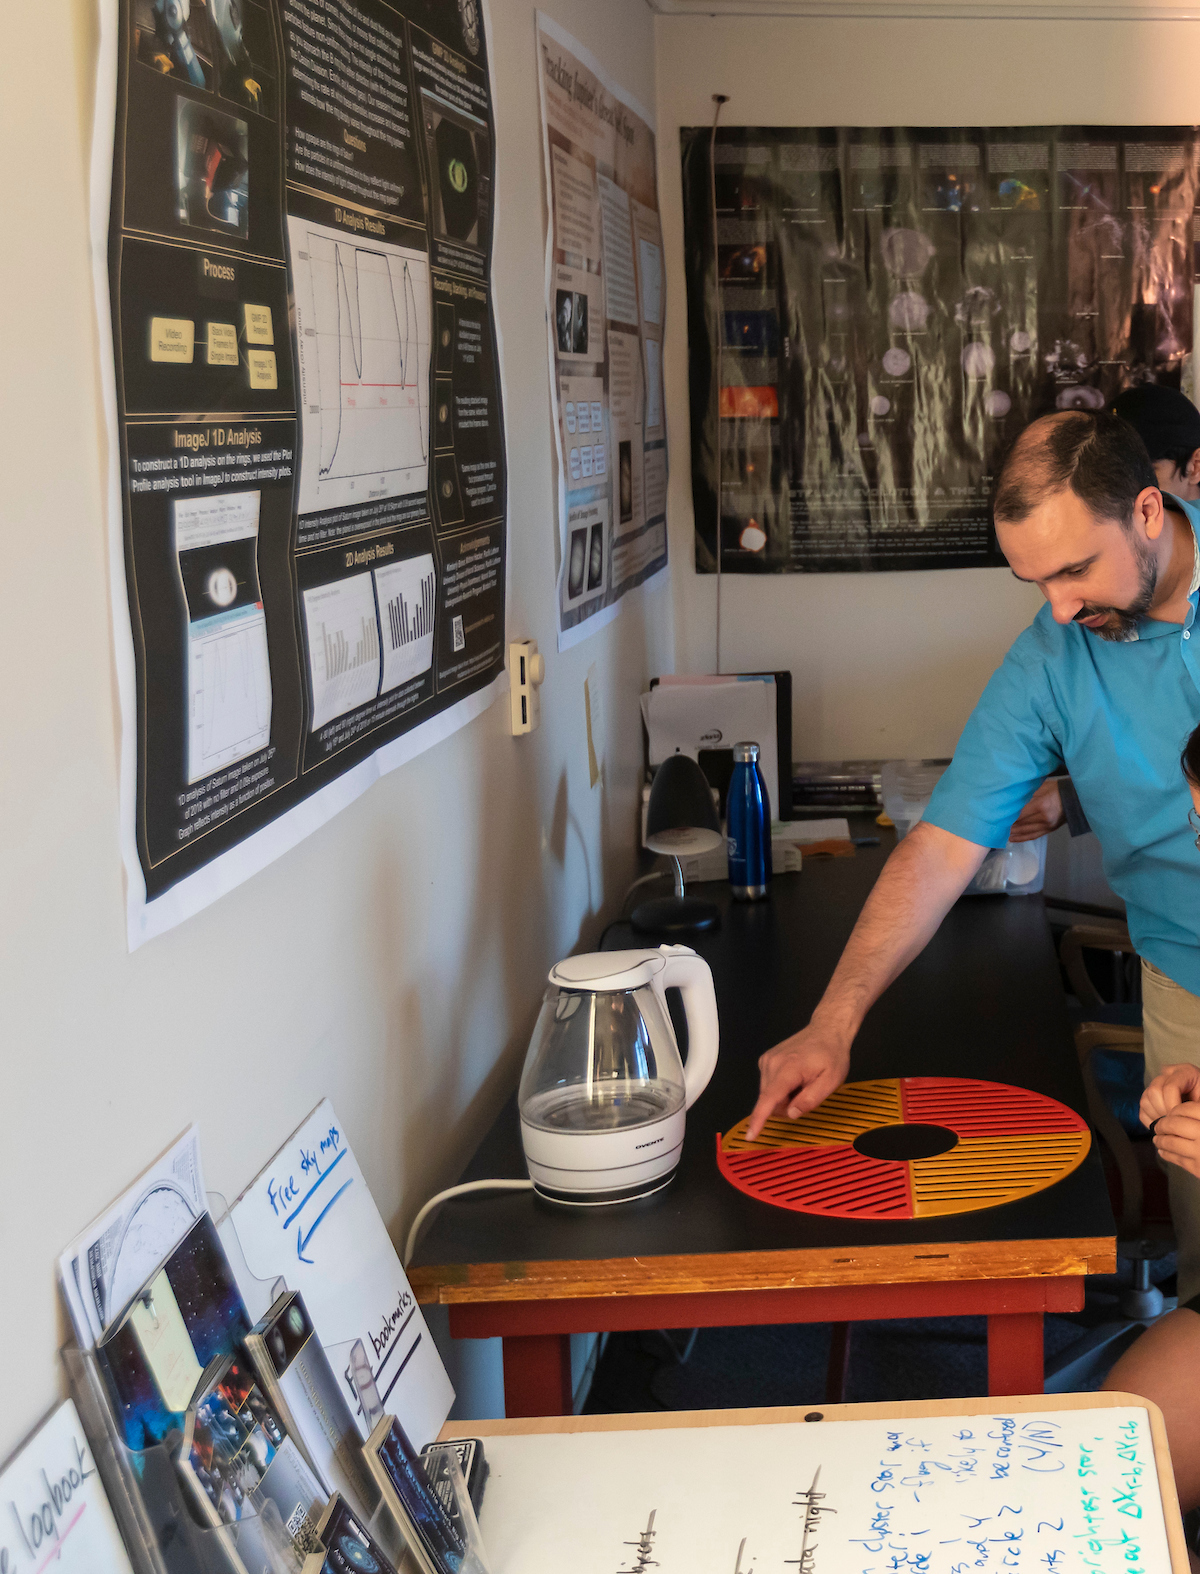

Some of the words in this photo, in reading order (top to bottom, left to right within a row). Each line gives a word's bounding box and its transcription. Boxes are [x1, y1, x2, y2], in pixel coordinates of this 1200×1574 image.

[344, 128, 366, 152] Questions
[343, 210, 365, 231] Analysis
[365, 217, 385, 235] Results
[204, 258, 235, 280] Process
[165, 328, 182, 339] Video
[212, 326, 223, 336] Stack
[223, 327, 234, 337] Video
[158, 340, 187, 354] Recording
[174, 429, 210, 451] ImageJ
[212, 428, 225, 446] 1D
[227, 428, 262, 448] Analysis
[133, 459, 142, 472] To
[142, 458, 172, 472] construct
[173, 460, 178, 469] a
[179, 456, 189, 468] 1D
[190, 455, 216, 469] analysis
[217, 457, 226, 466] on
[226, 454, 236, 465] the
[252, 454, 260, 463] we
[261, 451, 272, 461] used
[273, 450, 282, 460] the
[282, 449, 292, 460] Plot
[132, 479, 151, 492] Profile
[153, 476, 179, 492] analysis
[181, 474, 194, 487] tool
[195, 474, 202, 486] in
[202, 472, 224, 487] ImageJ
[225, 472, 231, 482] to
[231, 470, 257, 482] construct
[257, 467, 278, 480] intensity
[278, 466, 292, 478] plots.
[346, 552, 354, 568] 2D
[354, 547, 375, 565] Analysis
[376, 542, 394, 560] Results
[635, 1137, 664, 1150] OVENTE
[268, 1175, 300, 1216] Free
[300, 1149, 322, 1175] sky
[320, 1124, 340, 1154] maps
[368, 1290, 412, 1360] bookmarks
[952, 1429, 975, 1440] to
[948, 1447, 986, 1483] likely
[989, 1464, 1010, 1479] be
[10, 1436, 96, 1560] logbook
[791, 1490, 838, 1533] night
[997, 1505, 1023, 1517] 2
[848, 1501, 894, 1551] cluster
[1037, 1518, 1064, 1533] 2
[966, 1537, 990, 1567] and
